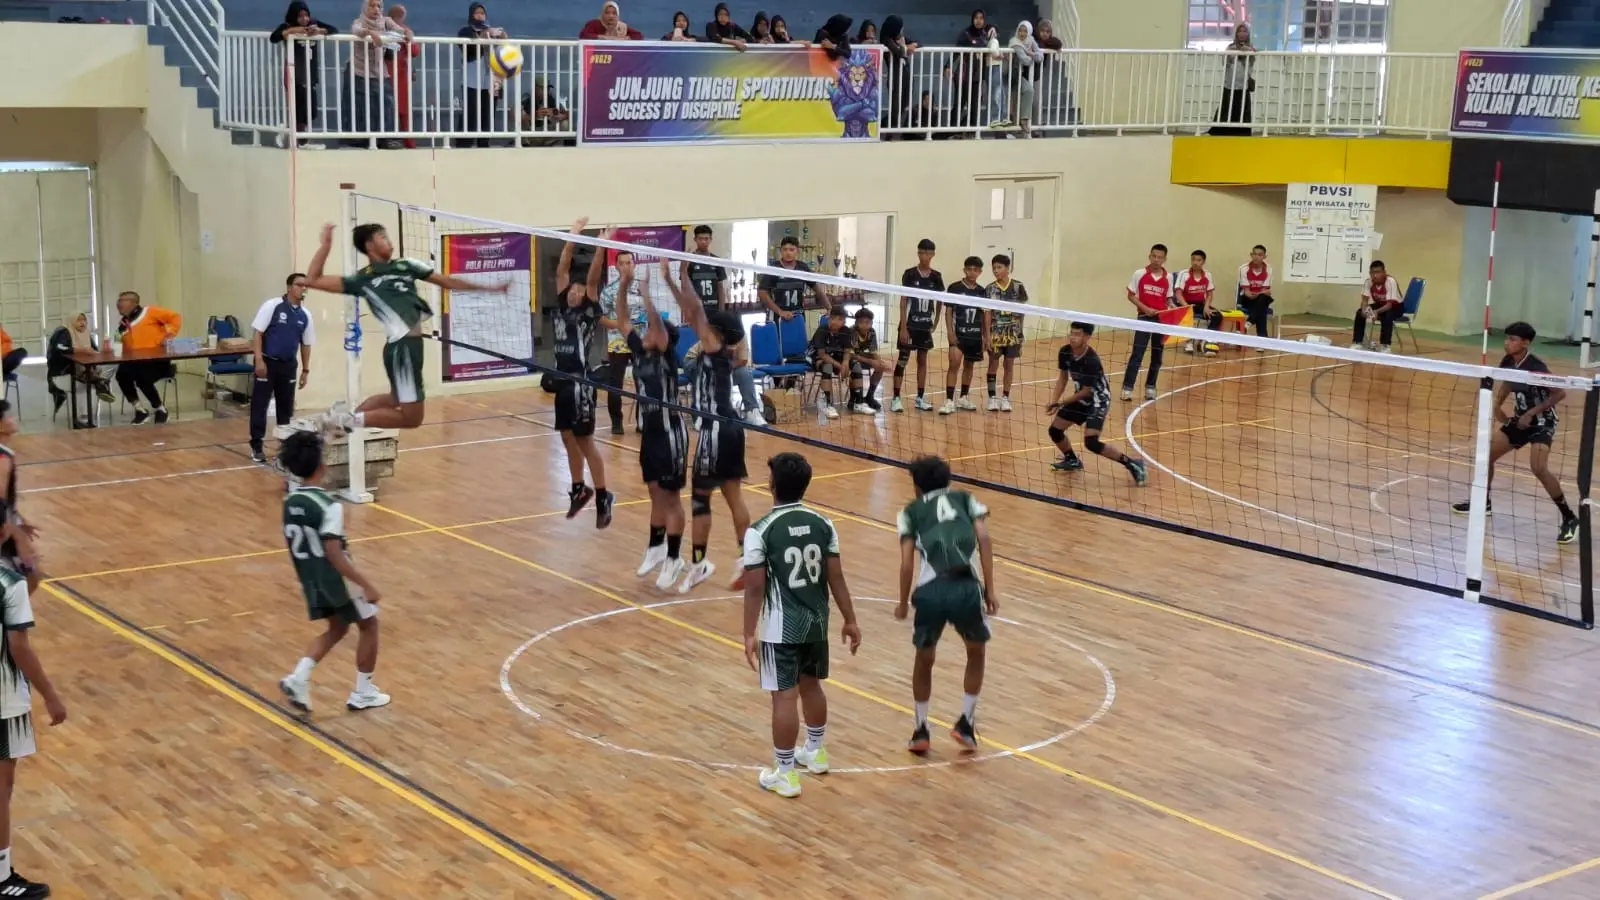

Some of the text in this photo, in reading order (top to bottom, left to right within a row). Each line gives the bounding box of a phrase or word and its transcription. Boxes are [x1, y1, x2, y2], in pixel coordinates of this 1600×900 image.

[608, 76, 684, 101] JUNJUNG
[687, 76, 738, 101] TINGGI
[1466, 71, 1531, 95] SEKOLAH
[1531, 74, 1581, 97] UNTUK
[608, 101, 742, 120] SUCCESS BY DISCIPLINE
[1463, 93, 1516, 116] KULIAH
[1309, 185, 1353, 197] PBVSI
[1314, 200, 1346, 208] WISATA
[1295, 251, 1308, 261] 20
[1350, 252, 1357, 261] 8
[701, 280, 713, 296] 15
[784, 289, 798, 307] 14
[965, 308, 977, 324] 17
[936, 495, 958, 523] 4
[784, 543, 822, 589] 28
